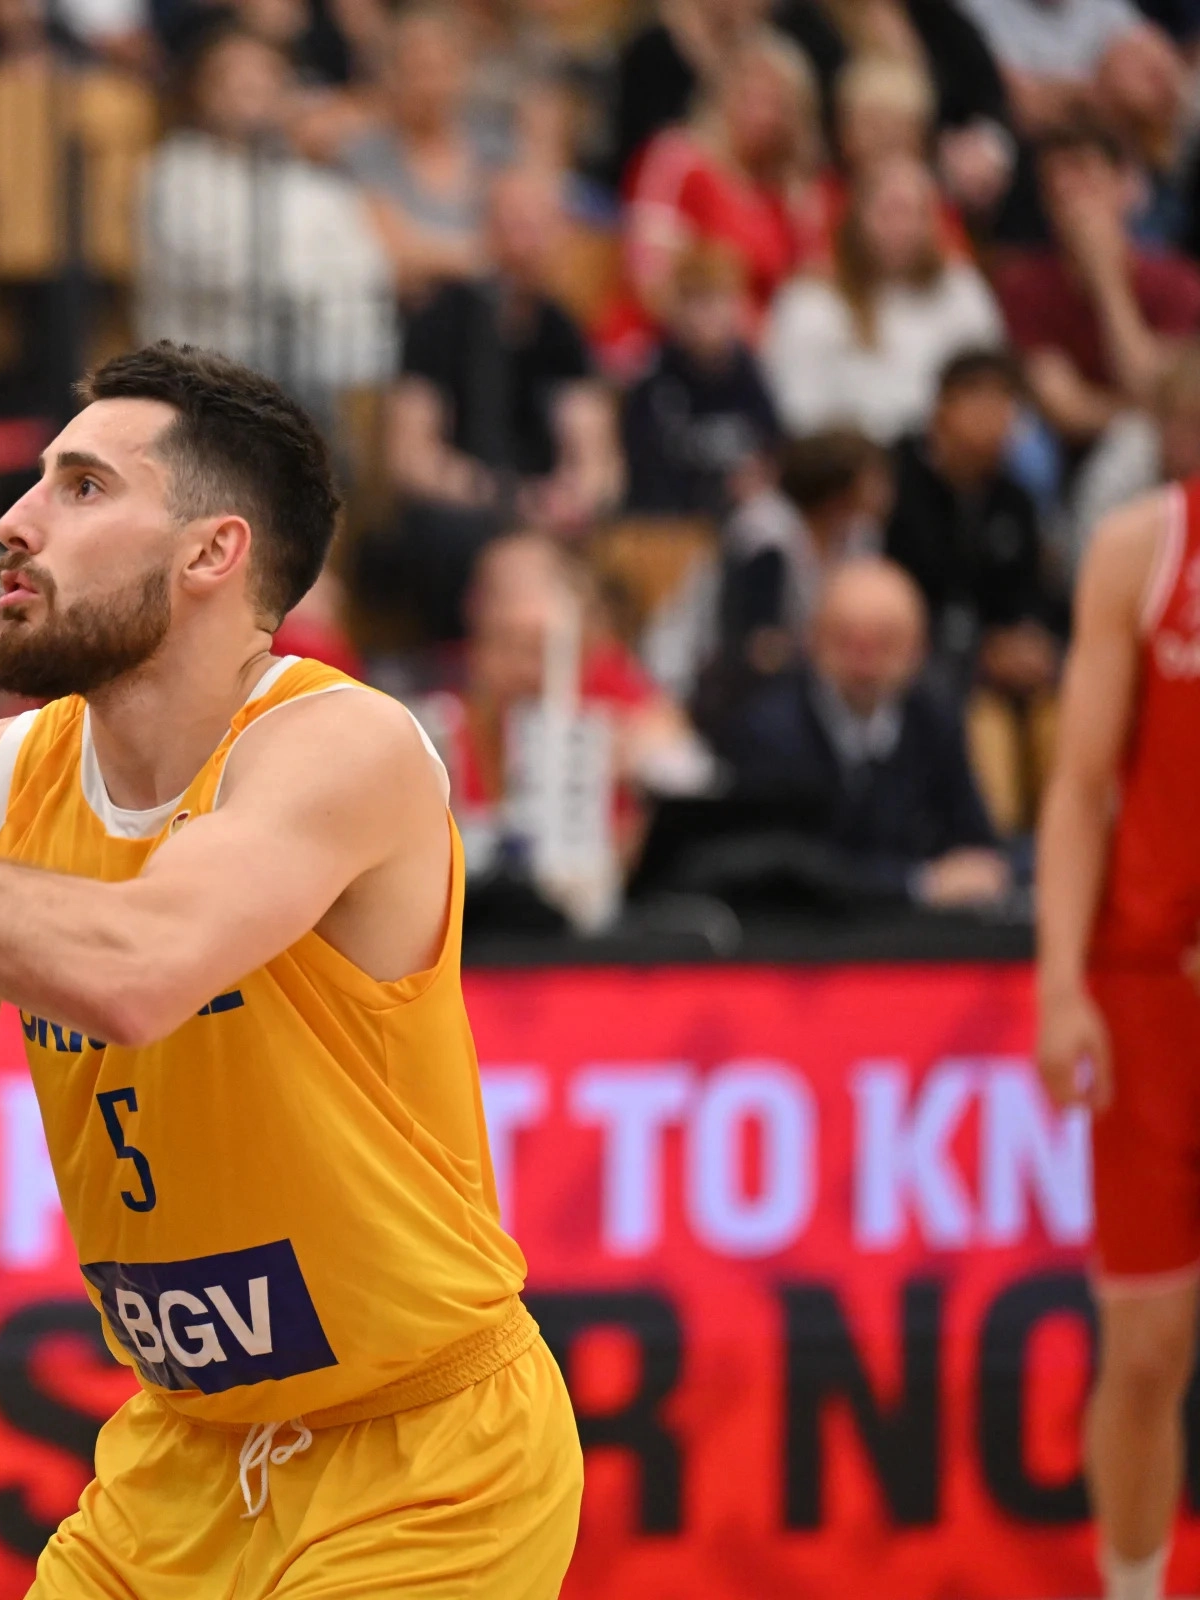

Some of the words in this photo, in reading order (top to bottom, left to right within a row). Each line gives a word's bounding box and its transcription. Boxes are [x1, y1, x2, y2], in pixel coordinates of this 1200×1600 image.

[96, 1087, 156, 1213] 5
[568, 1059, 817, 1256] TO
[115, 1275, 273, 1368] BGV
[778, 1266, 1200, 1532] NO
